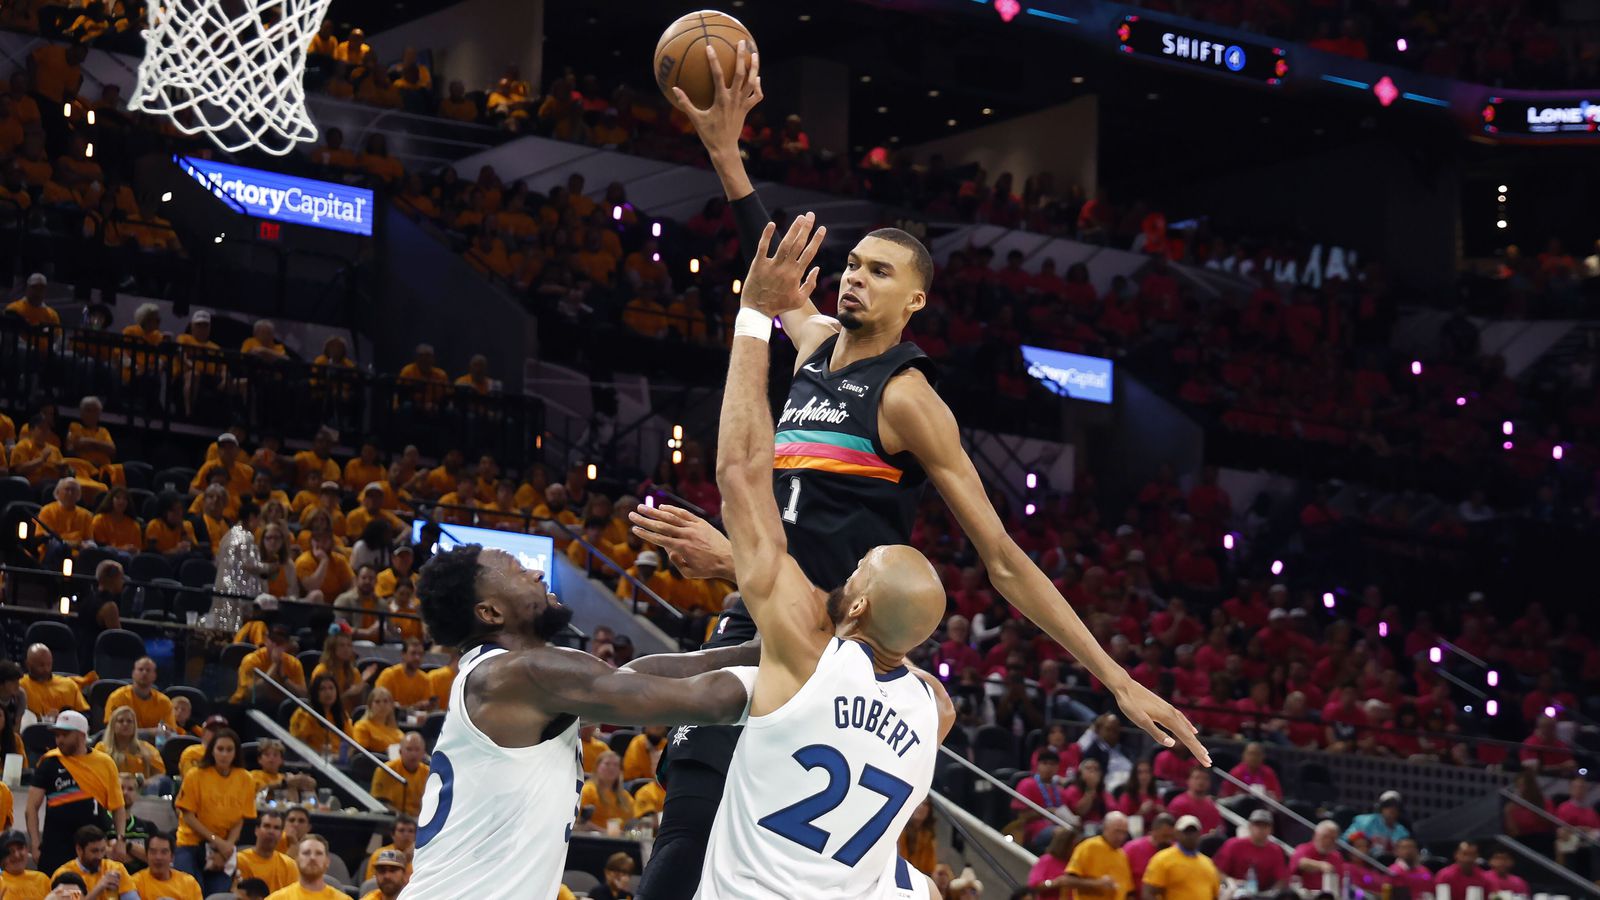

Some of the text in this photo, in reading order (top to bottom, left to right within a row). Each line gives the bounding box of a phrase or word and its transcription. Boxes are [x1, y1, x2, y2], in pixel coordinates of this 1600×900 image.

[1162, 33, 1241, 67] SHIFT4
[843, 382, 864, 394] LEDGER
[793, 396, 850, 425] Antonio
[782, 476, 801, 524] 1
[834, 696, 920, 758] GOBERT
[757, 743, 914, 868] 27
